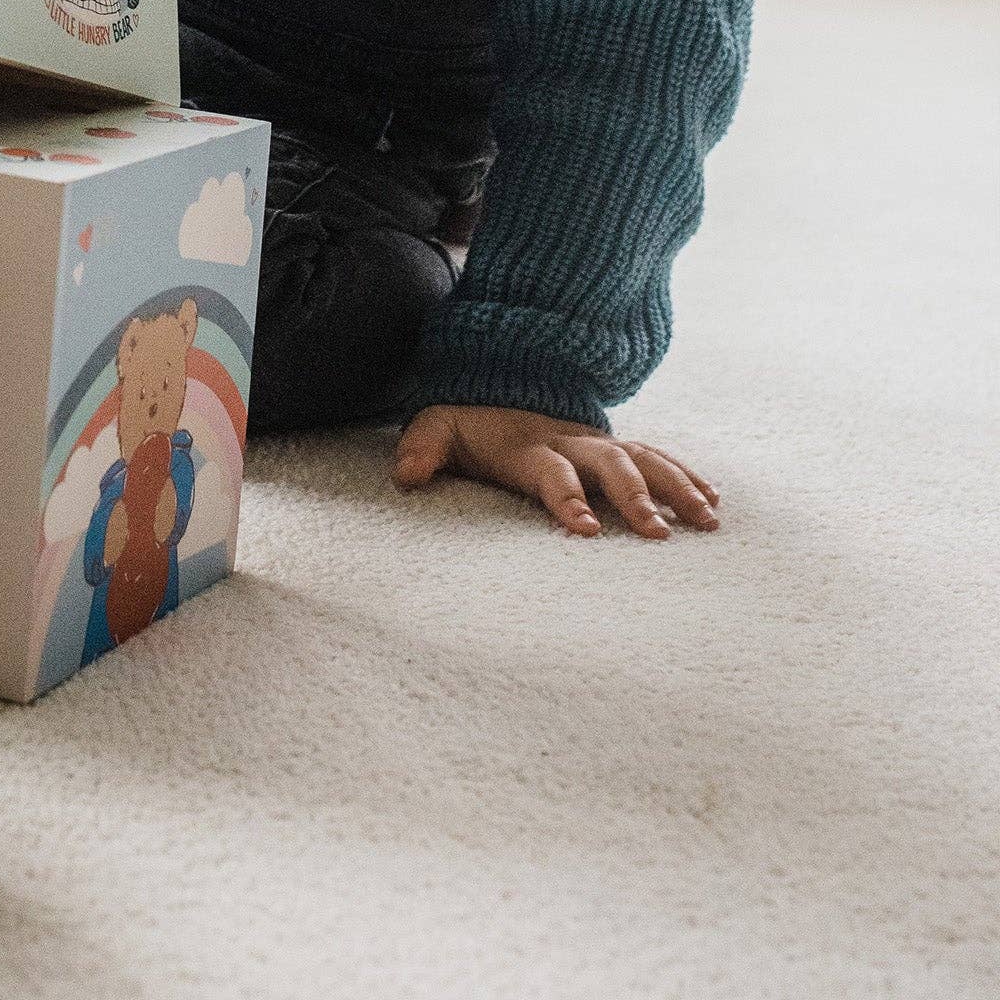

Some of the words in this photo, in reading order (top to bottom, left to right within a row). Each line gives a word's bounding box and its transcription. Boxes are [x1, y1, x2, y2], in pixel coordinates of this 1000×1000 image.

[50, 0, 76, 37] LITTLE
[78, 21, 112, 46] HUNGRY
[112, 15, 133, 43] BEAR
